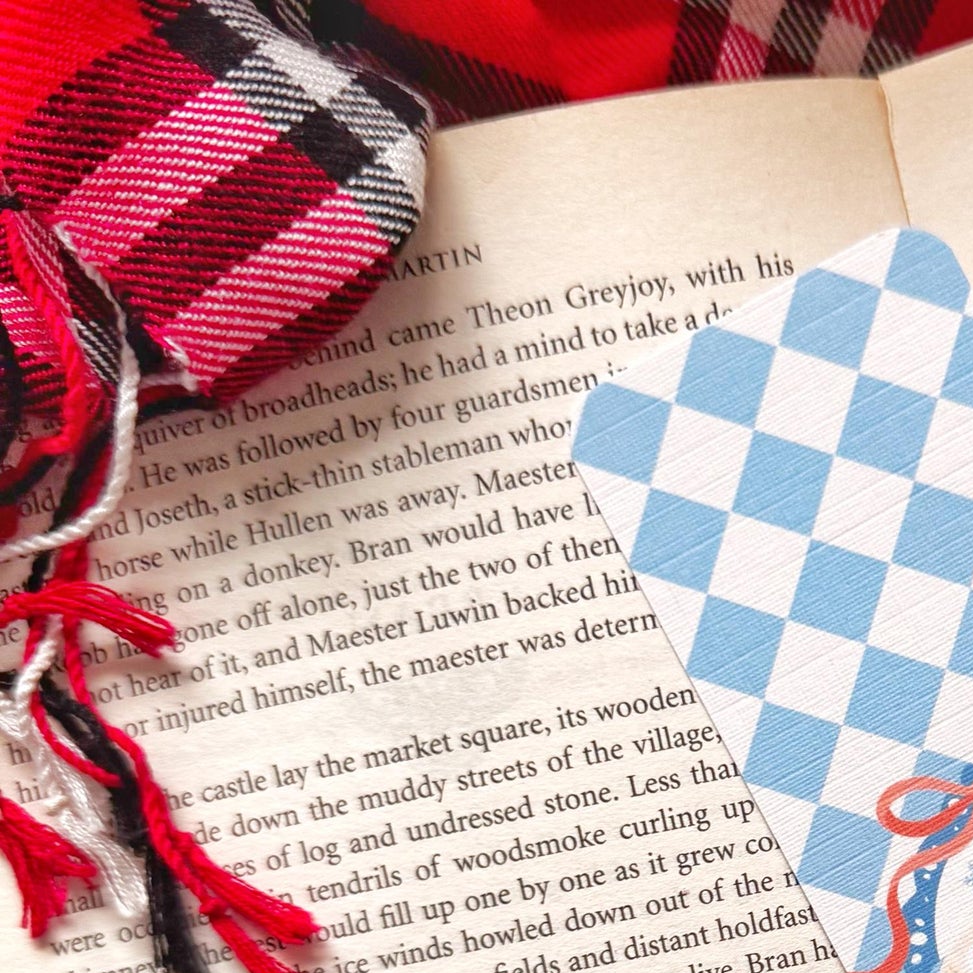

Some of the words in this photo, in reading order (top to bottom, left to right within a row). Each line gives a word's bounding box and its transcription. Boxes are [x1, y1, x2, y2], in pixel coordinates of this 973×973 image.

[465, 296, 554, 328] Theon
[564, 274, 676, 310] Greyjoy,
[684, 257, 746, 289] with
[455, 372, 598, 423] guardsmen
[243, 510, 334, 546] Hullen
[340, 500, 389, 524] was
[397, 484, 467, 513] away.
[253, 636, 303, 669] and
[305, 620, 409, 657] Maester
[413, 598, 500, 635] Luwin
[502, 574, 598, 616] backed
[156, 689, 248, 732] injured
[250, 666, 355, 711] himself,
[359, 660, 402, 687] the
[408, 641, 510, 678] maester
[516, 630, 567, 655] was
[200, 770, 268, 803] castle
[271, 764, 309, 791] lay
[314, 753, 357, 779] the
[362, 733, 454, 770] market
[459, 718, 552, 754] square,
[556, 706, 588, 731] its
[592, 683, 698, 722] wooden
[305, 864, 403, 904] tendrils
[414, 853, 442, 882] of
[451, 824, 608, 873] woodsmoke
[618, 807, 712, 840] curling
[720, 798, 755, 824] up
